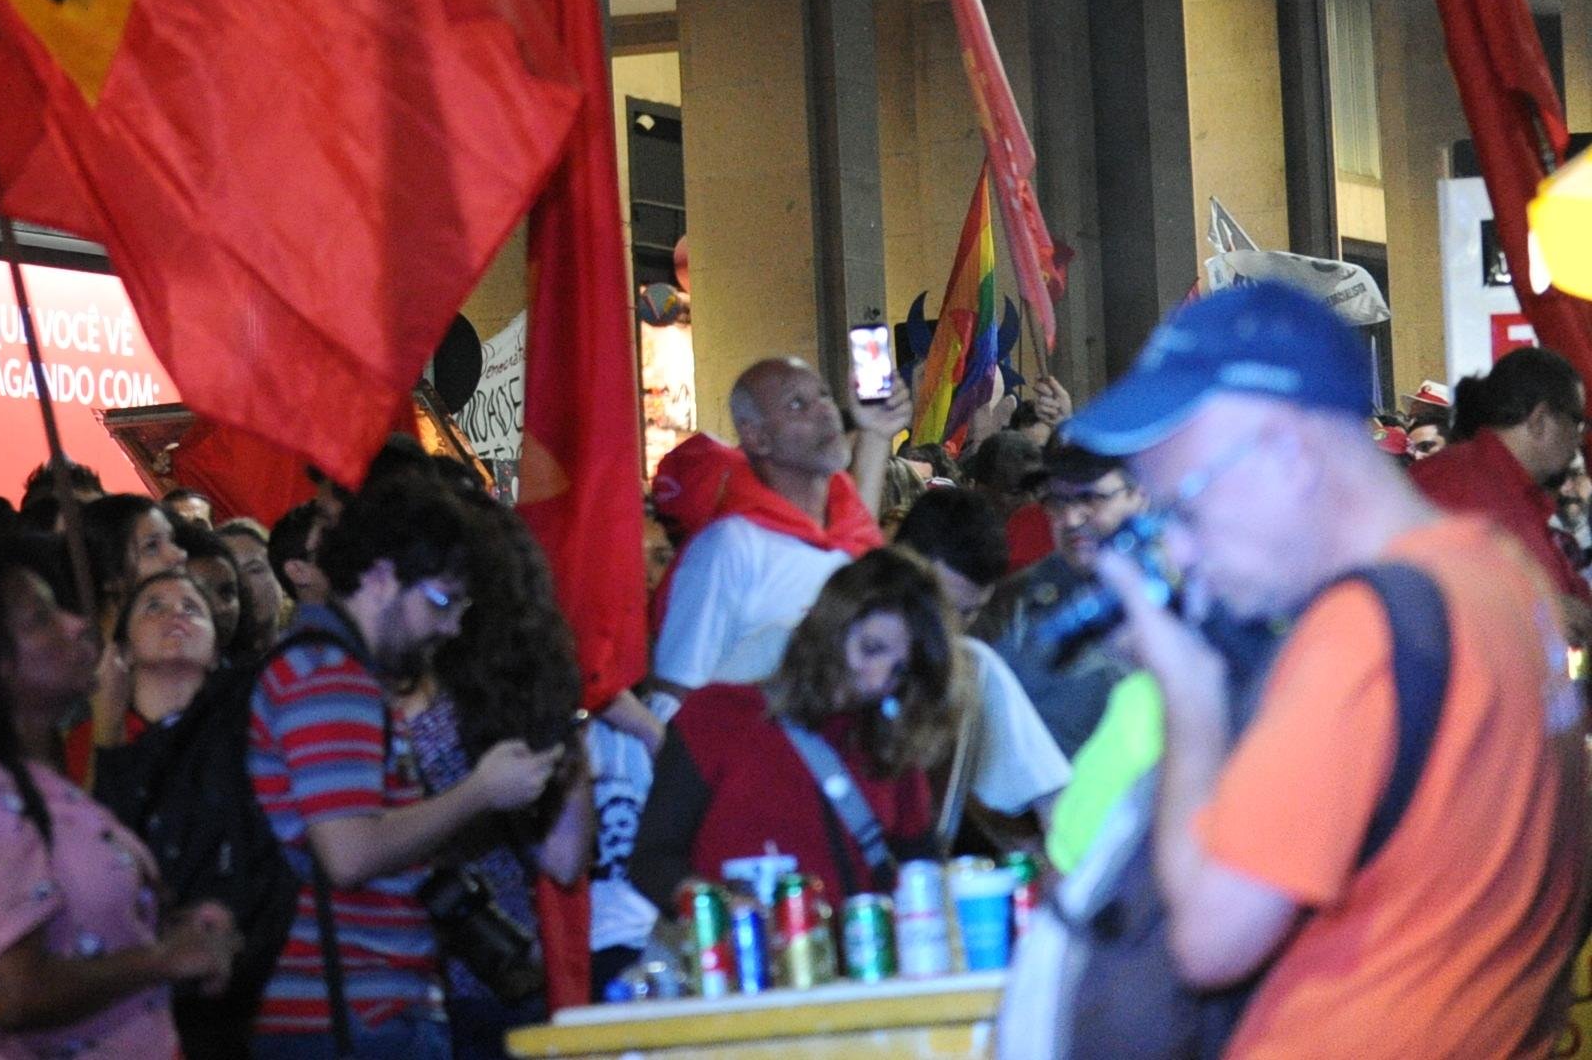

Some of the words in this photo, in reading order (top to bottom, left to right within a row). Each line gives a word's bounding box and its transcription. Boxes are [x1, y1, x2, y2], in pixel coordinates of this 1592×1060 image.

[35, 303, 101, 354] VOCÊ
[102, 306, 135, 357] VÊ
[99, 369, 160, 409] COM:
